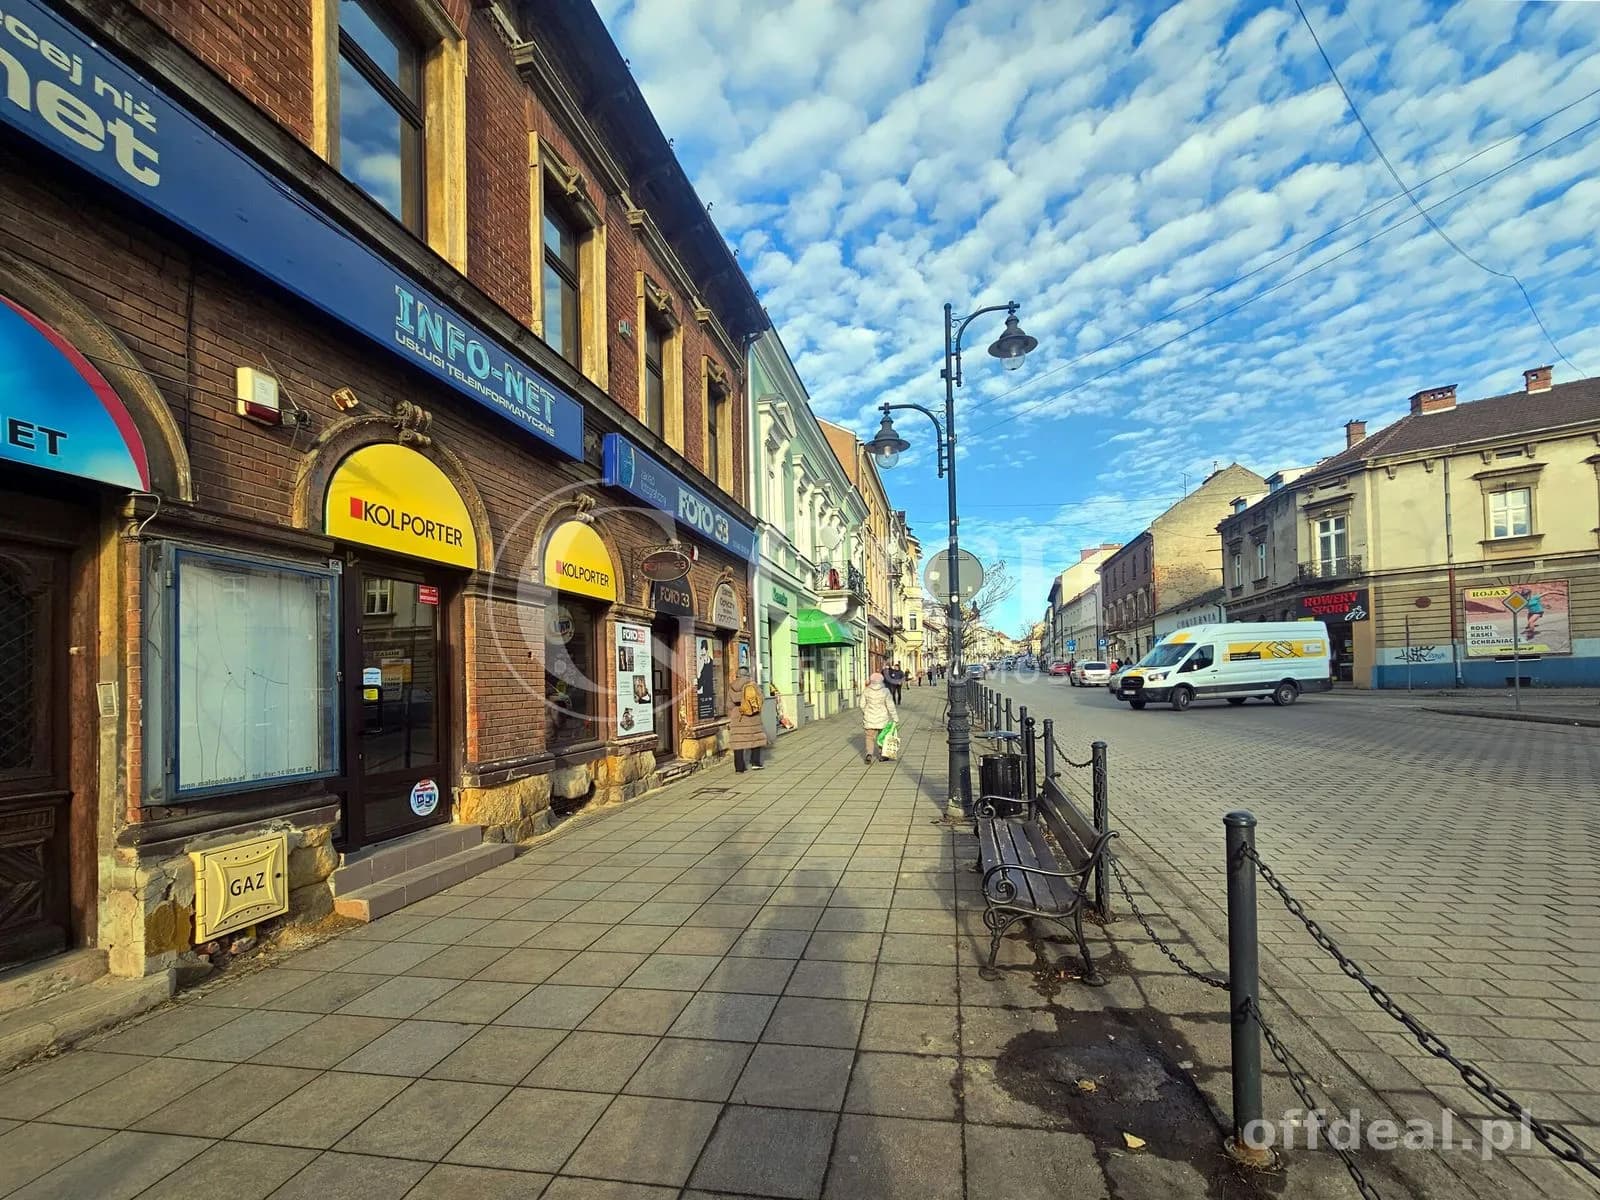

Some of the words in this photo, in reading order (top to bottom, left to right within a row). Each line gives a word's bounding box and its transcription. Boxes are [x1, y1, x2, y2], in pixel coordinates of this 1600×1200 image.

[0, 9, 83, 86] cej
[94, 74, 158, 134] niż
[394, 284, 556, 424] INFO-NET
[394, 330, 445, 369] USŁUGI
[446, 361, 555, 438] TELEINFORMATYCZNE
[363, 500, 463, 548] KOLPORTER
[678, 486, 714, 535] FOTO
[562, 560, 610, 588] KOLPORTER
[660, 585, 681, 606] FOTO
[1303, 591, 1358, 607] ROWERY
[1471, 589, 1509, 598] ROJAX
[621, 628, 638, 641] FOTO
[230, 871, 265, 897] GAZ
